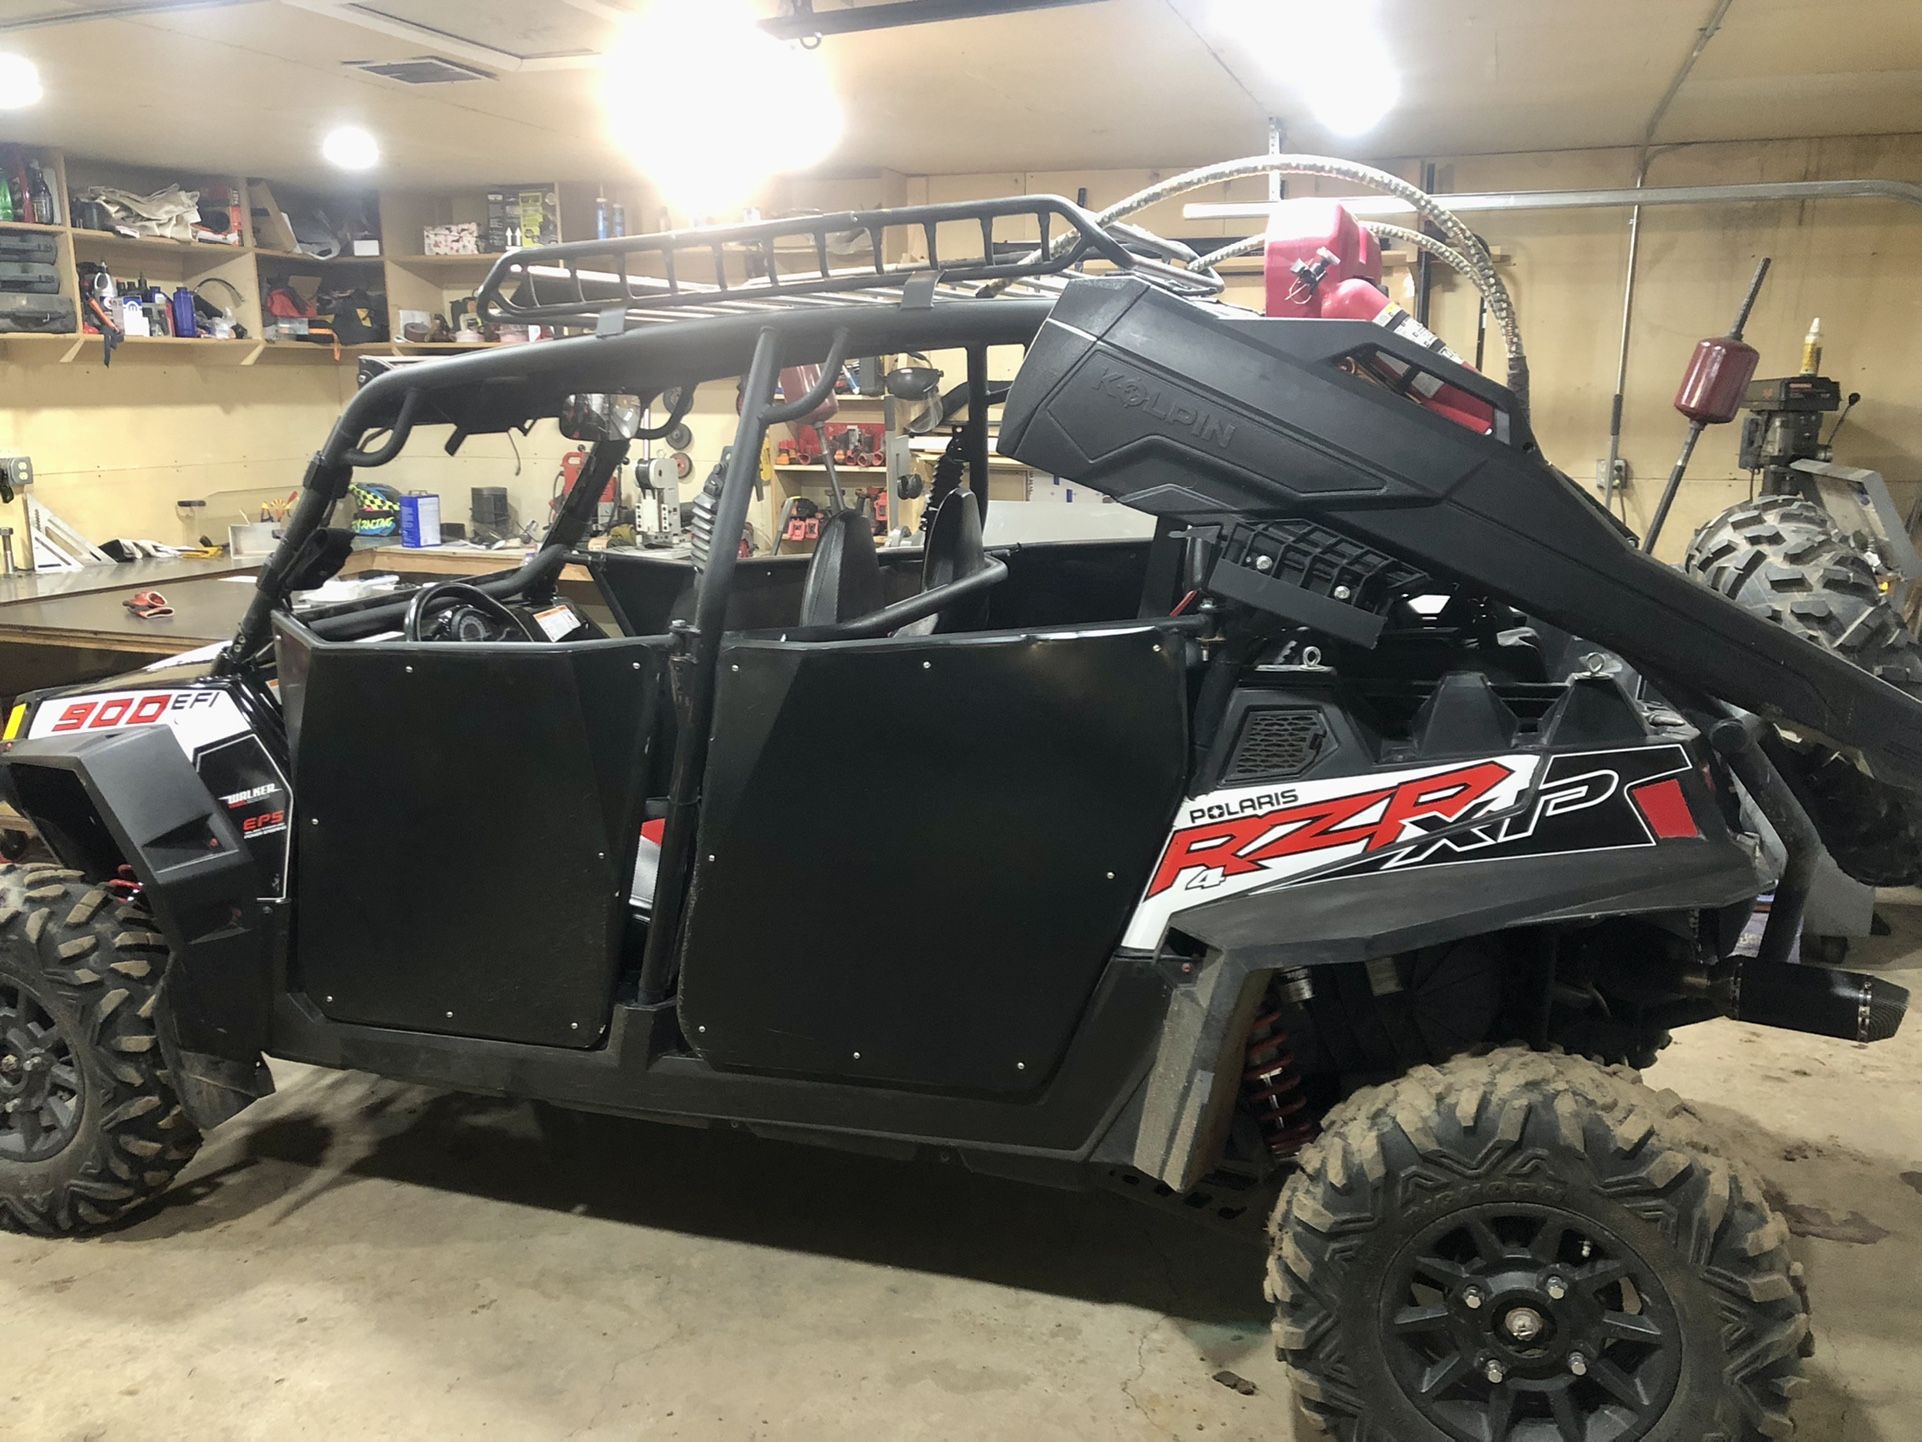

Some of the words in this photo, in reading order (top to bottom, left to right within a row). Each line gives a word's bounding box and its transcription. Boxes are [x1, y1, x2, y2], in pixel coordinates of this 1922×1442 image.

[1091, 367, 1237, 449] KOLPIN
[51, 693, 173, 732] 900
[170, 691, 220, 711] EFI
[222, 783, 279, 804] WALKER
[1190, 789, 1299, 824] POLARIS
[242, 810, 285, 831] EPS
[1147, 760, 1515, 902] RZR
[1379, 769, 1620, 870] XP
